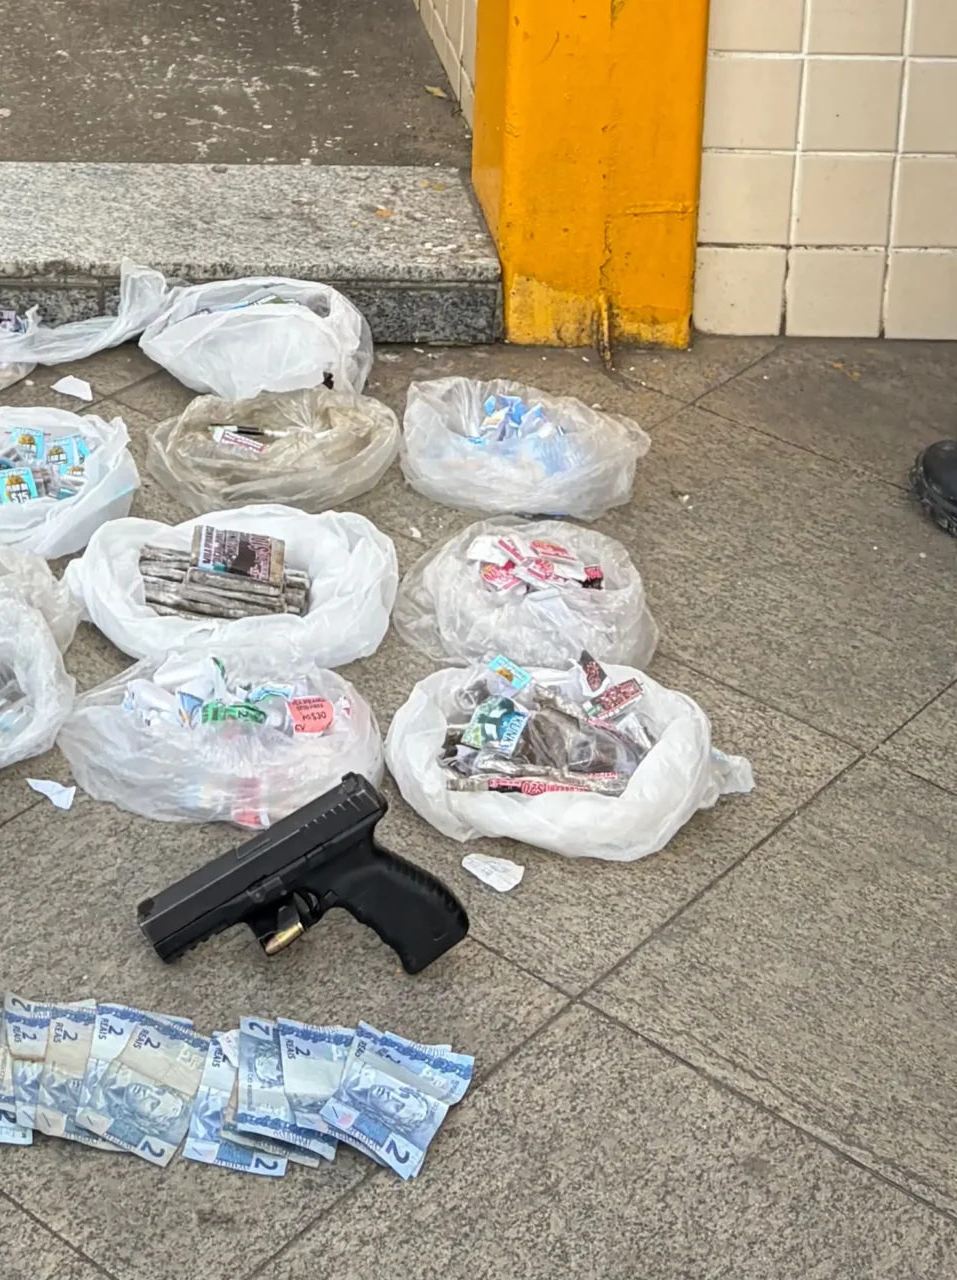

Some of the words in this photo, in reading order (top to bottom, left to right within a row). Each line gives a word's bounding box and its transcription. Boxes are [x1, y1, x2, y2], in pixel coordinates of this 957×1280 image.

[11, 997, 31, 1012] 2
[63, 1030, 78, 1041] 2
[108, 1025, 124, 1036] 2
[249, 1022, 270, 1036] 2
[22, 1031, 37, 1041] 2
[144, 1037, 161, 1049] 2
[295, 1046, 310, 1057] 2
[141, 1136, 166, 1158] 2
[385, 1142, 411, 1165] 2
[254, 1156, 278, 1171] 2
